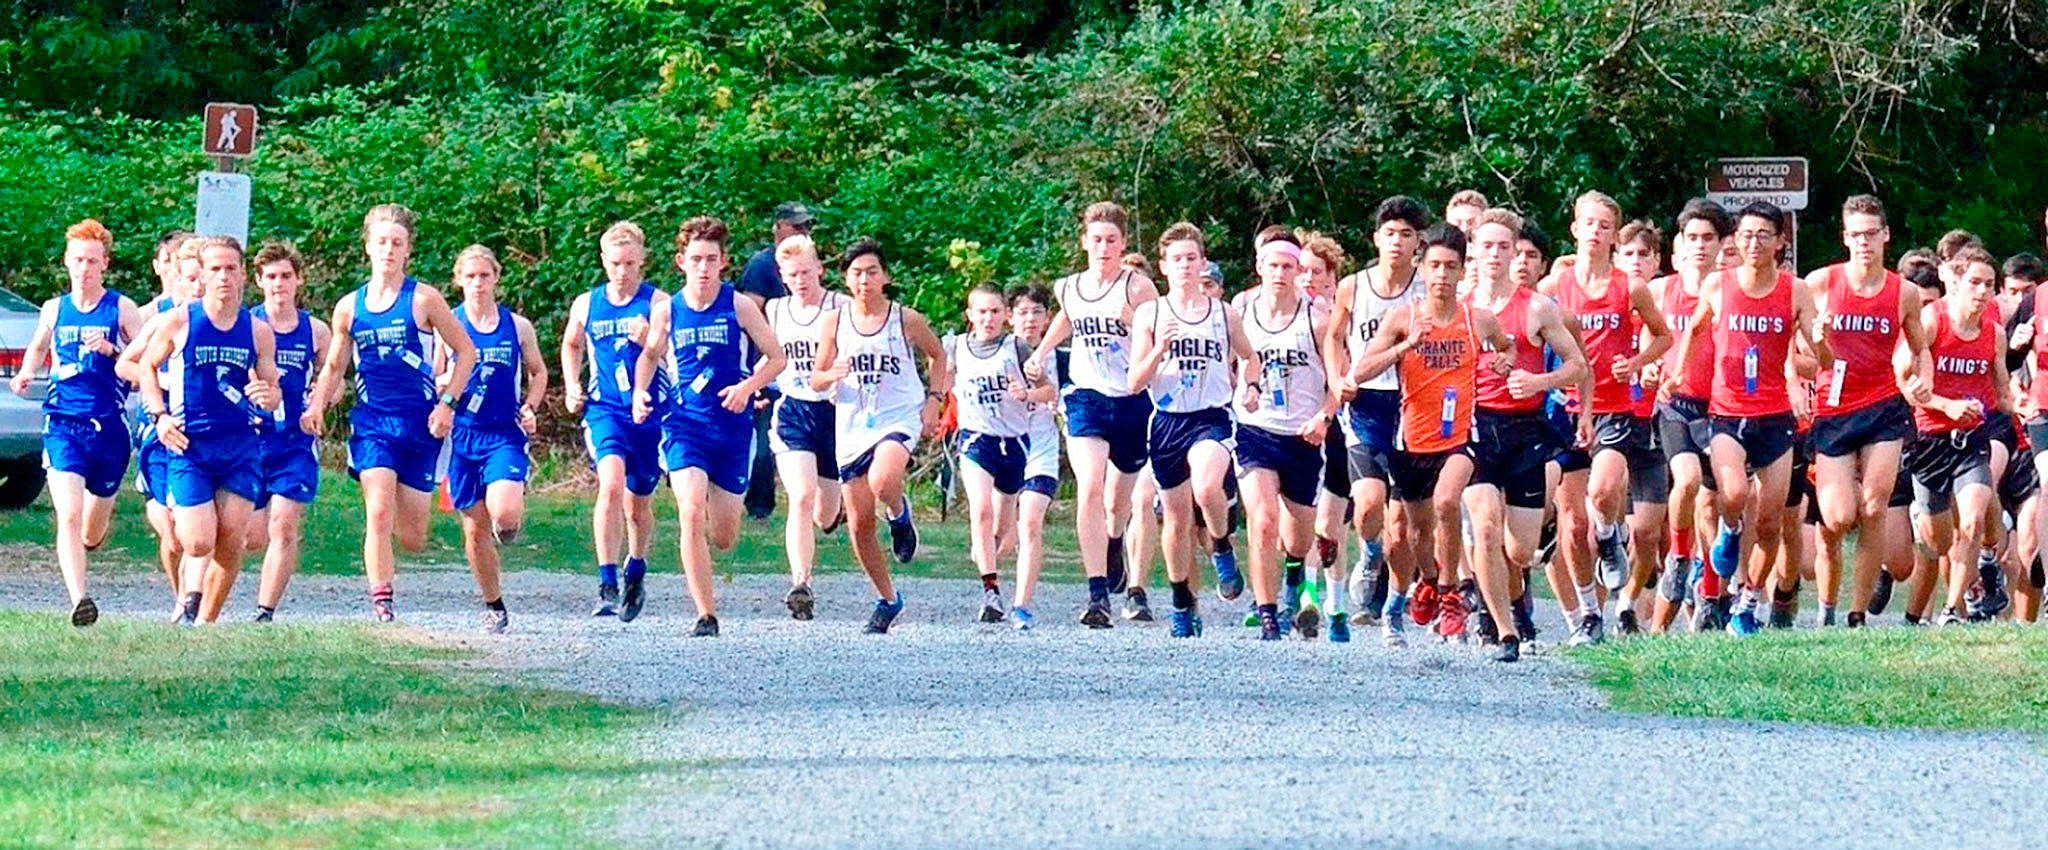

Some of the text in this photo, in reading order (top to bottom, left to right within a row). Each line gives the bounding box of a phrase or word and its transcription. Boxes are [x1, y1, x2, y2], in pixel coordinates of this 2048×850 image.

[1723, 164, 1790, 176] MOTORIZED
[1729, 177, 1785, 188] VEHICLES
[1073, 316, 1128, 337] AGLES
[1576, 313, 1620, 330] NG'S
[1729, 314, 1783, 333] KING'S
[1833, 314, 1890, 334] KING'S
[1169, 338, 1223, 362] AGLES
[1417, 341, 1465, 354] GRANITE
[848, 353, 901, 375] AGLES
[1179, 360, 1206, 370] HC
[1424, 355, 1460, 369] FALLS
[1937, 356, 1989, 374] KING'S
